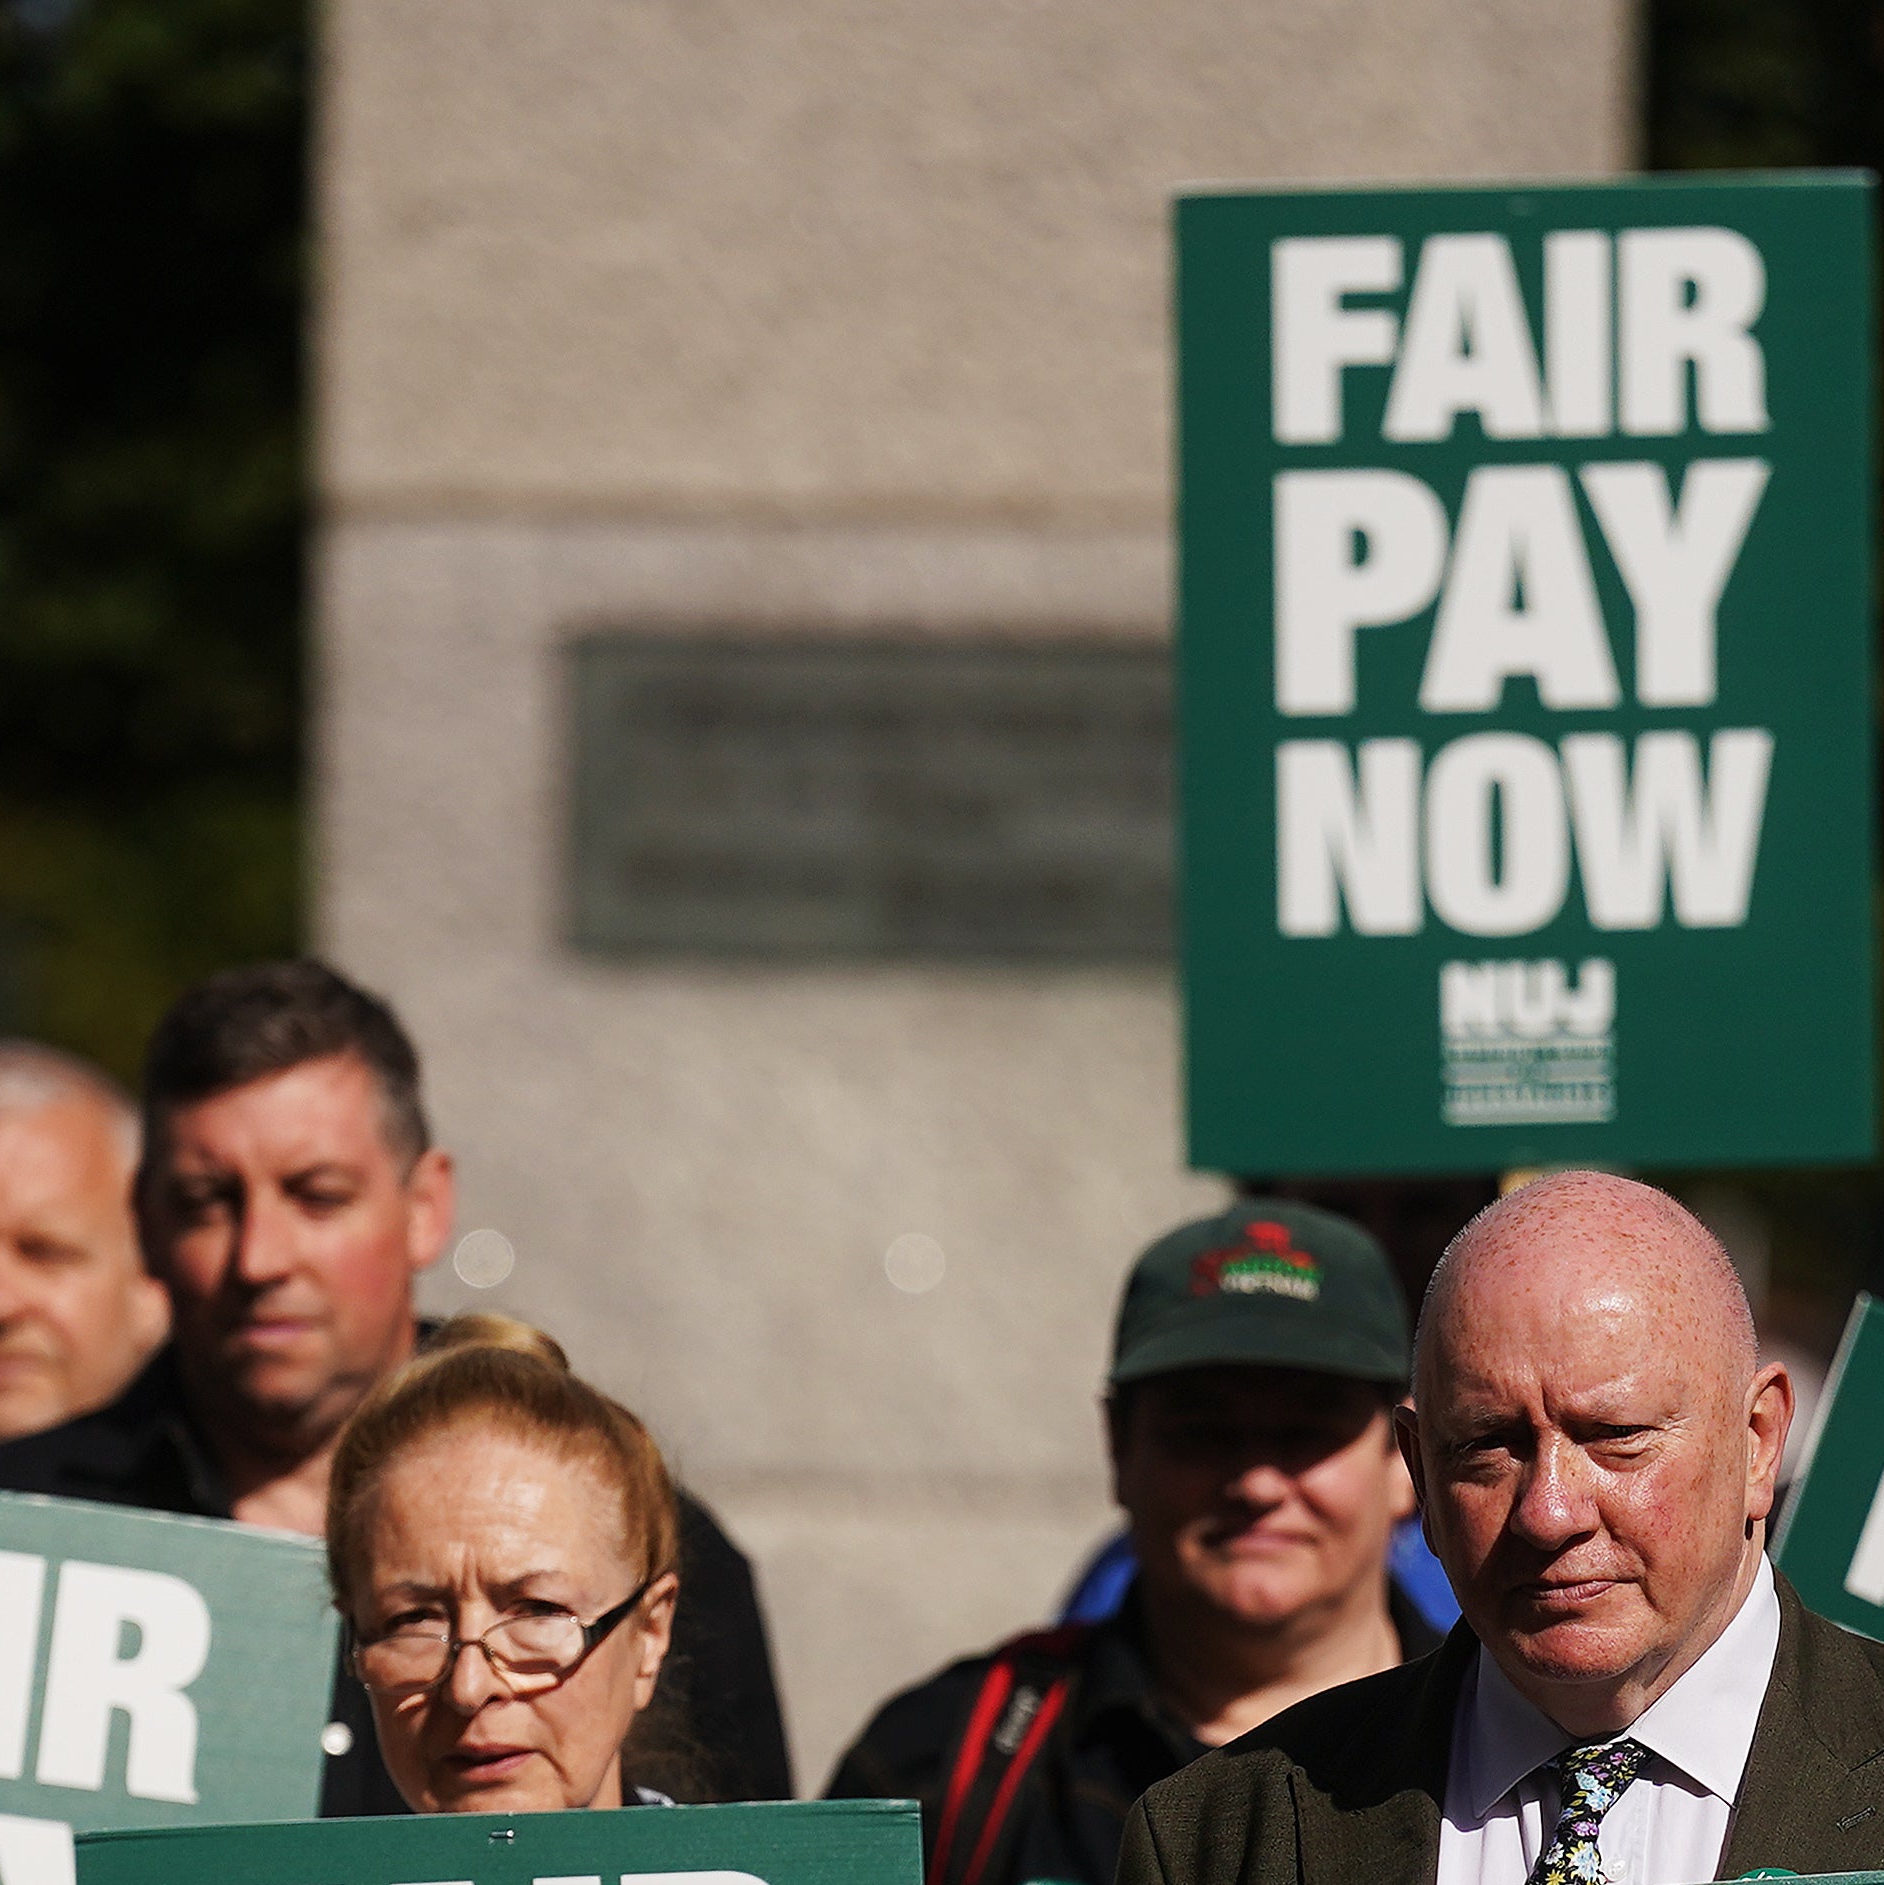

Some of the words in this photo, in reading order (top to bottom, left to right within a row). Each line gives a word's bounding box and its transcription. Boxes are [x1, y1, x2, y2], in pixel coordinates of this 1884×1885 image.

[1272, 226, 1771, 443] FAIR
[1273, 459, 1772, 716] PAY
[1275, 729, 1774, 938] NOW
[1440, 959, 1617, 1040] NUJ
